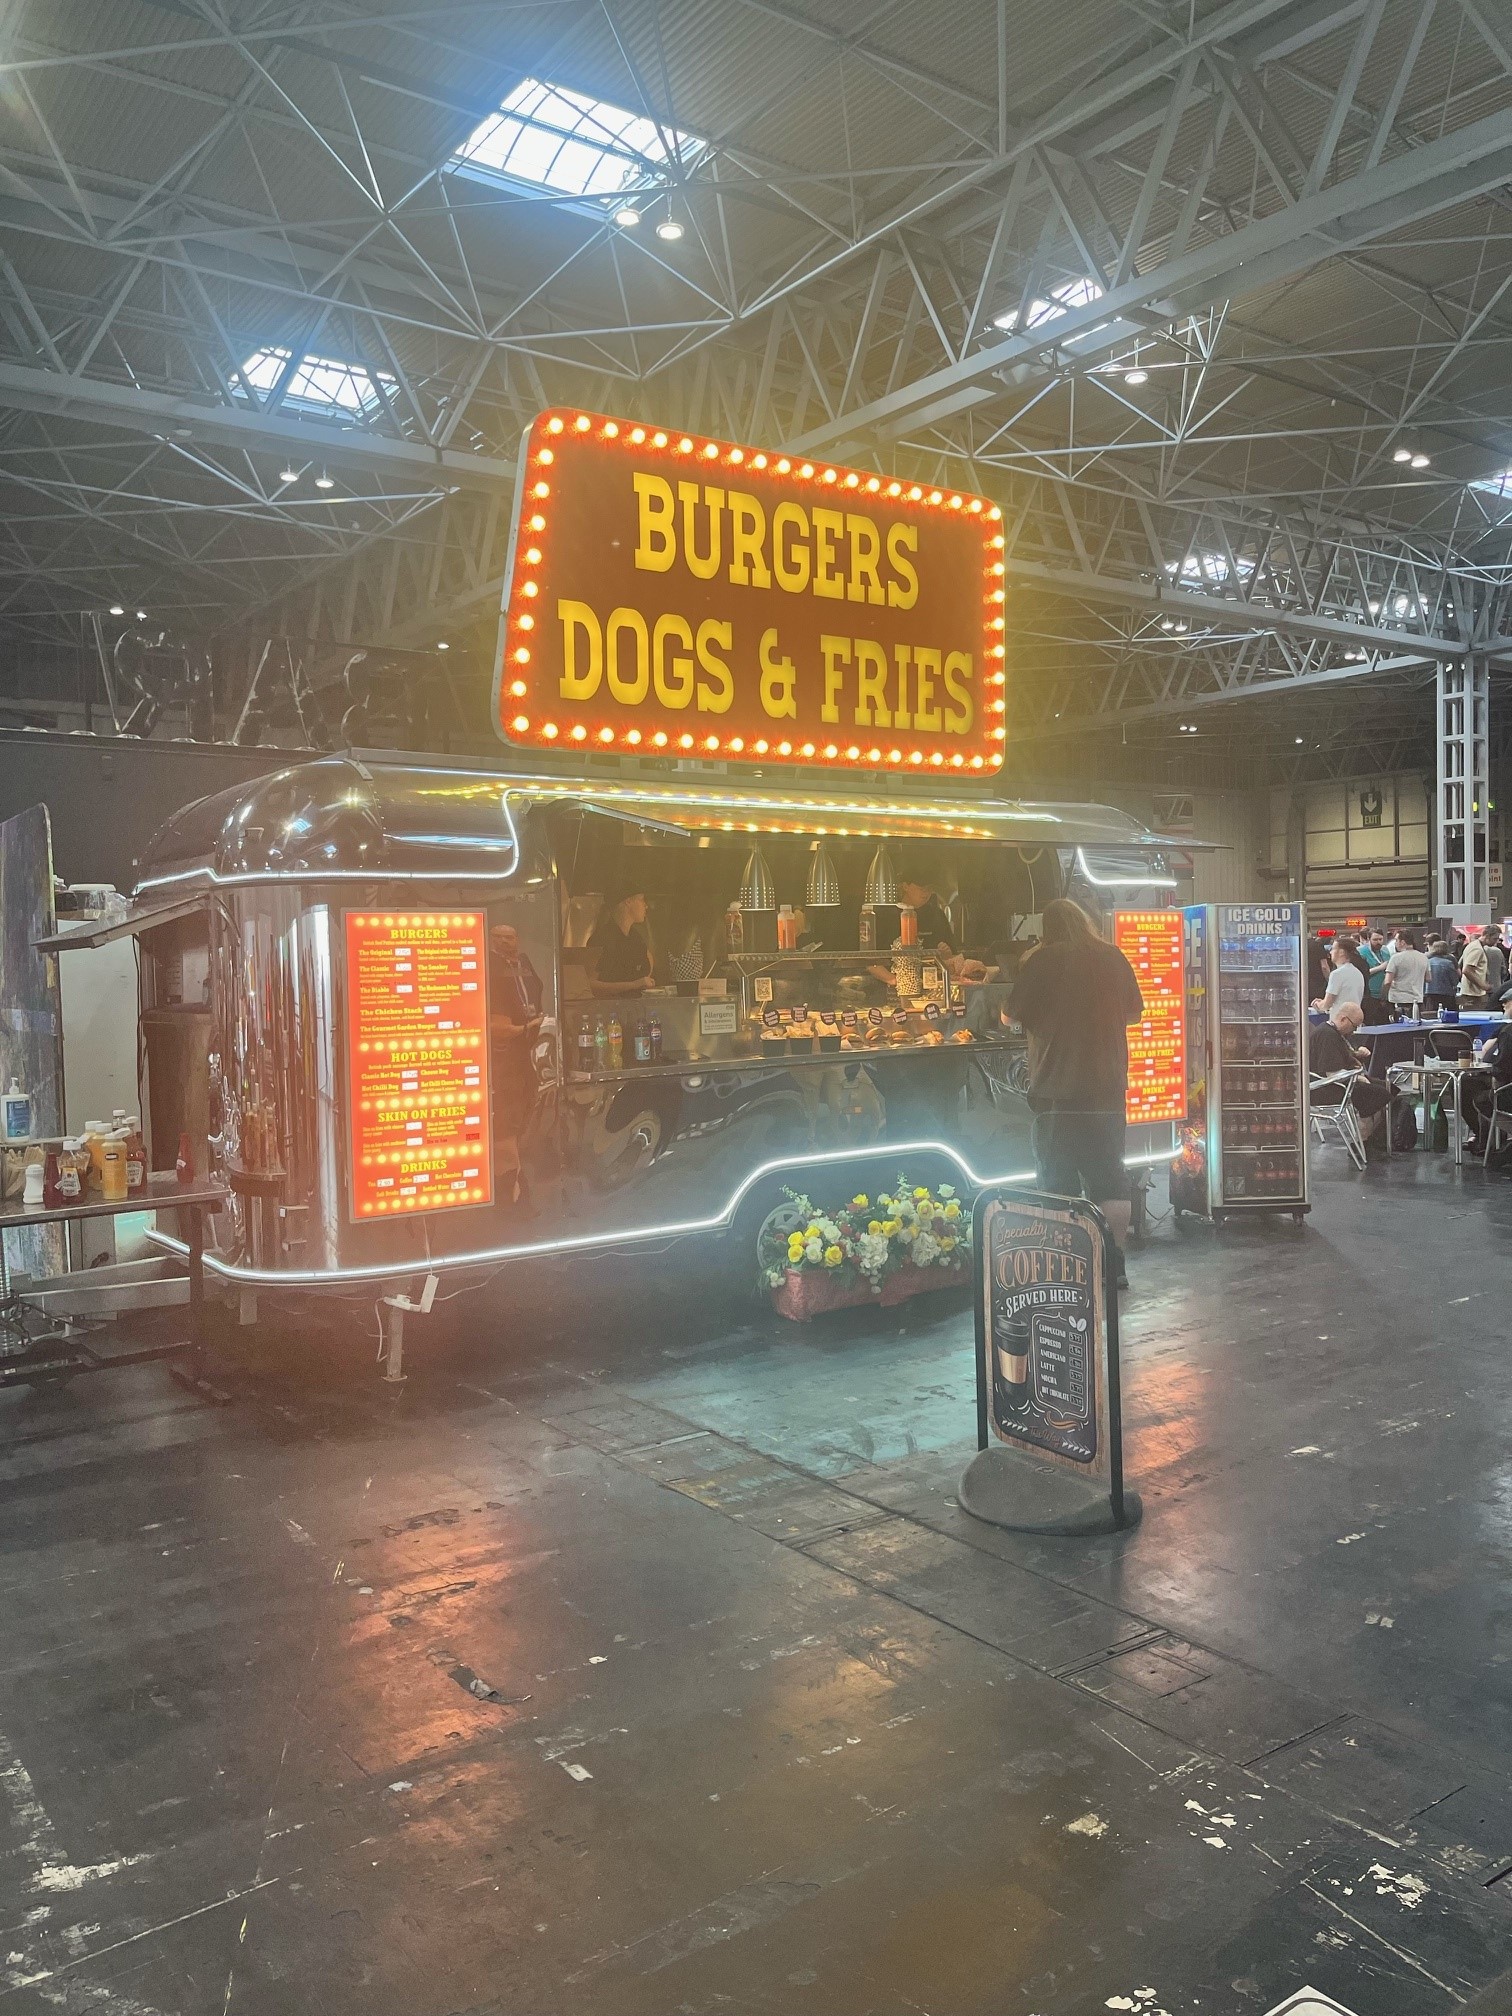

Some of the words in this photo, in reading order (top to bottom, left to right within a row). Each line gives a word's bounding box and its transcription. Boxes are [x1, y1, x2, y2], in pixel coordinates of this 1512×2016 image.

[633, 471, 919, 610] BURGERS
[557, 599, 735, 714] DOGS
[759, 628, 797, 719] &
[820, 634, 974, 734] FRIES
[1228, 908, 1250, 922] ICE
[1255, 908, 1291, 921] COLD
[1136, 923, 1165, 931] BURGERS
[1237, 923, 1283, 935] DRINKS
[390, 929, 448, 939] BURGERS
[1184, 918, 1202, 968] CE
[704, 1011, 734, 1019] Allergens
[1152, 1008, 1168, 1016] DOGS
[391, 1052, 418, 1062] HOT
[420, 1049, 452, 1061] DOGS
[1131, 1050, 1146, 1059] SKIN
[1148, 1049, 1157, 1057] ON
[1157, 1048, 1175, 1057] FRIES
[1142, 1086, 1166, 1095] DRINKS
[378, 1110, 408, 1122] SKIN
[411, 1109, 428, 1120] ON
[431, 1106, 466, 1118] FRIES
[400, 1159, 447, 1174] DRINKS
[998, 1249, 1087, 1288] COFFEE
[1005, 1291, 1047, 1318] SERVED
[1050, 1289, 1078, 1303] HERE
[1039, 1324, 1066, 1338] CAPPUCCINO
[1039, 1336, 1062, 1349] ESPRESSO
[1040, 1349, 1066, 1363] AMERICANO
[1040, 1361, 1055, 1372] LATTE
[1040, 1374, 1058, 1385] MOCHA
[1041, 1386, 1049, 1395] HOT
[1049, 1388, 1070, 1402] CHOCOLATE
